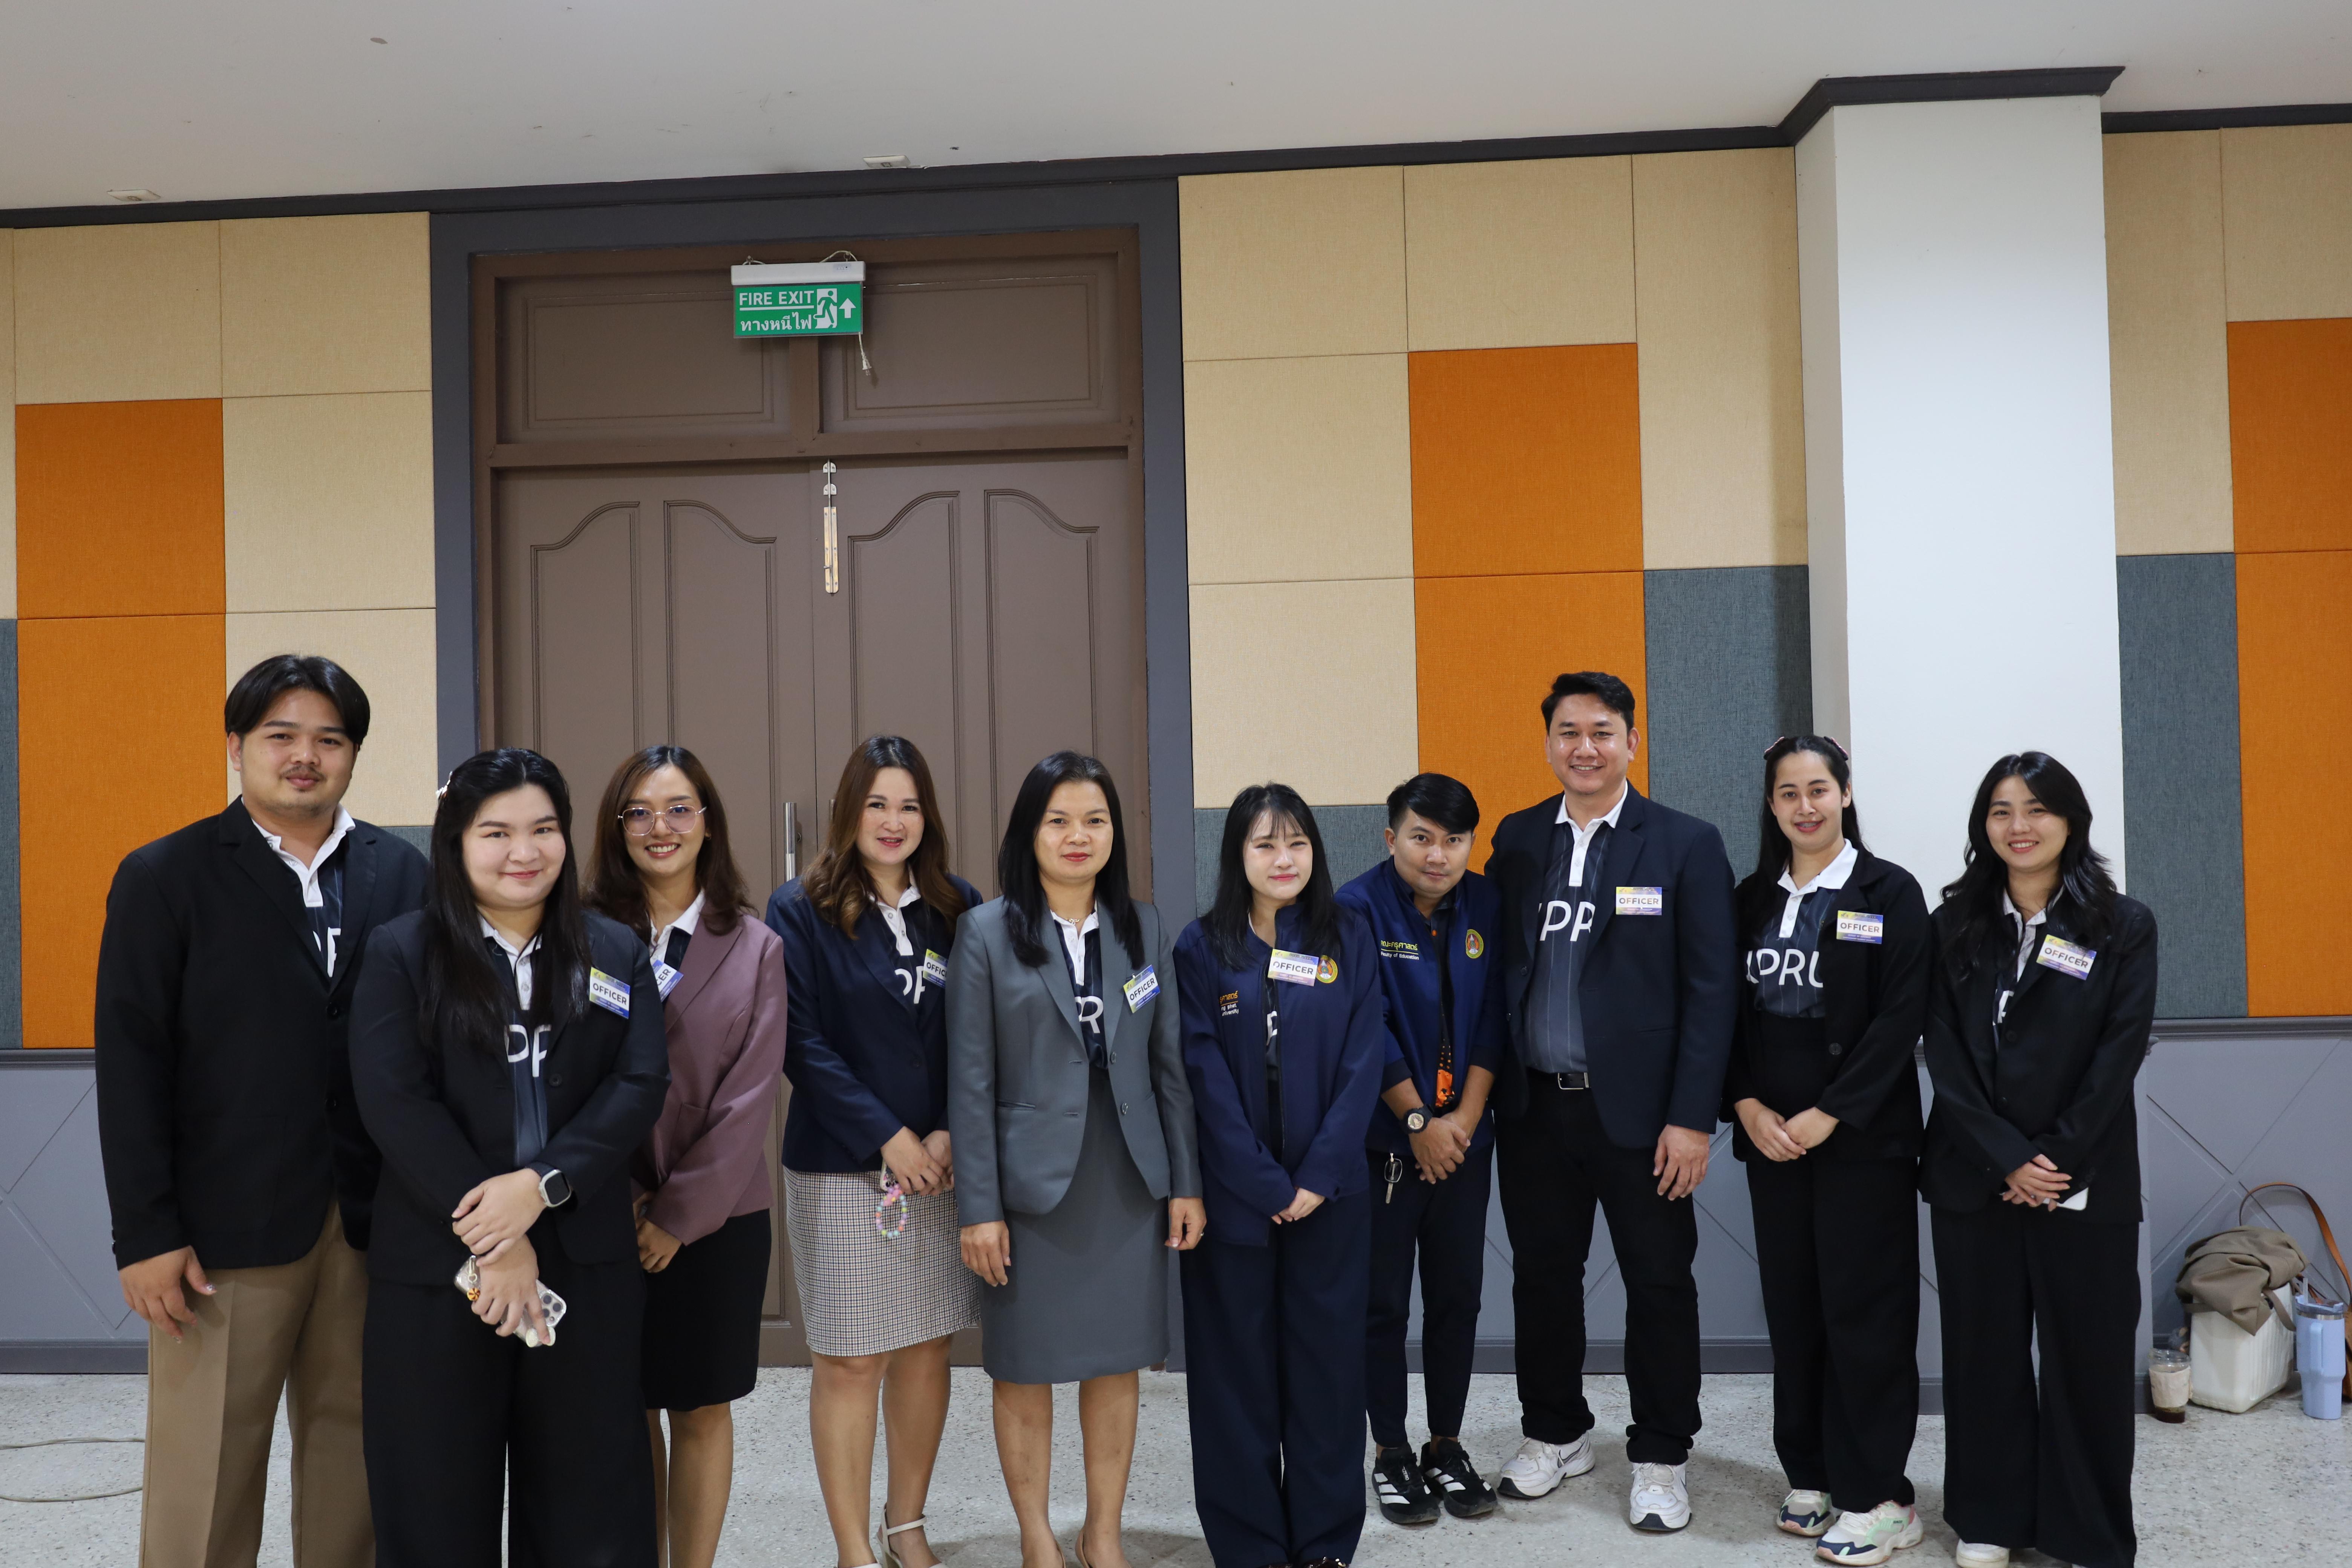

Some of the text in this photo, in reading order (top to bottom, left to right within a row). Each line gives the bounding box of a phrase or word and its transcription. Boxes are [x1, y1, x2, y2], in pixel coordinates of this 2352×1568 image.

[740, 291, 814, 305] FIRE EXIT
[740, 311, 812, 331] ทางหนีไฟ
[1840, 922, 1880, 933] OFFICER
[1273, 961, 1314, 975] OFFICER
[2044, 948, 2088, 968] OFFICER
[593, 983, 627, 1005] OFFICER
[1130, 978, 1155, 1001] OFFICER
